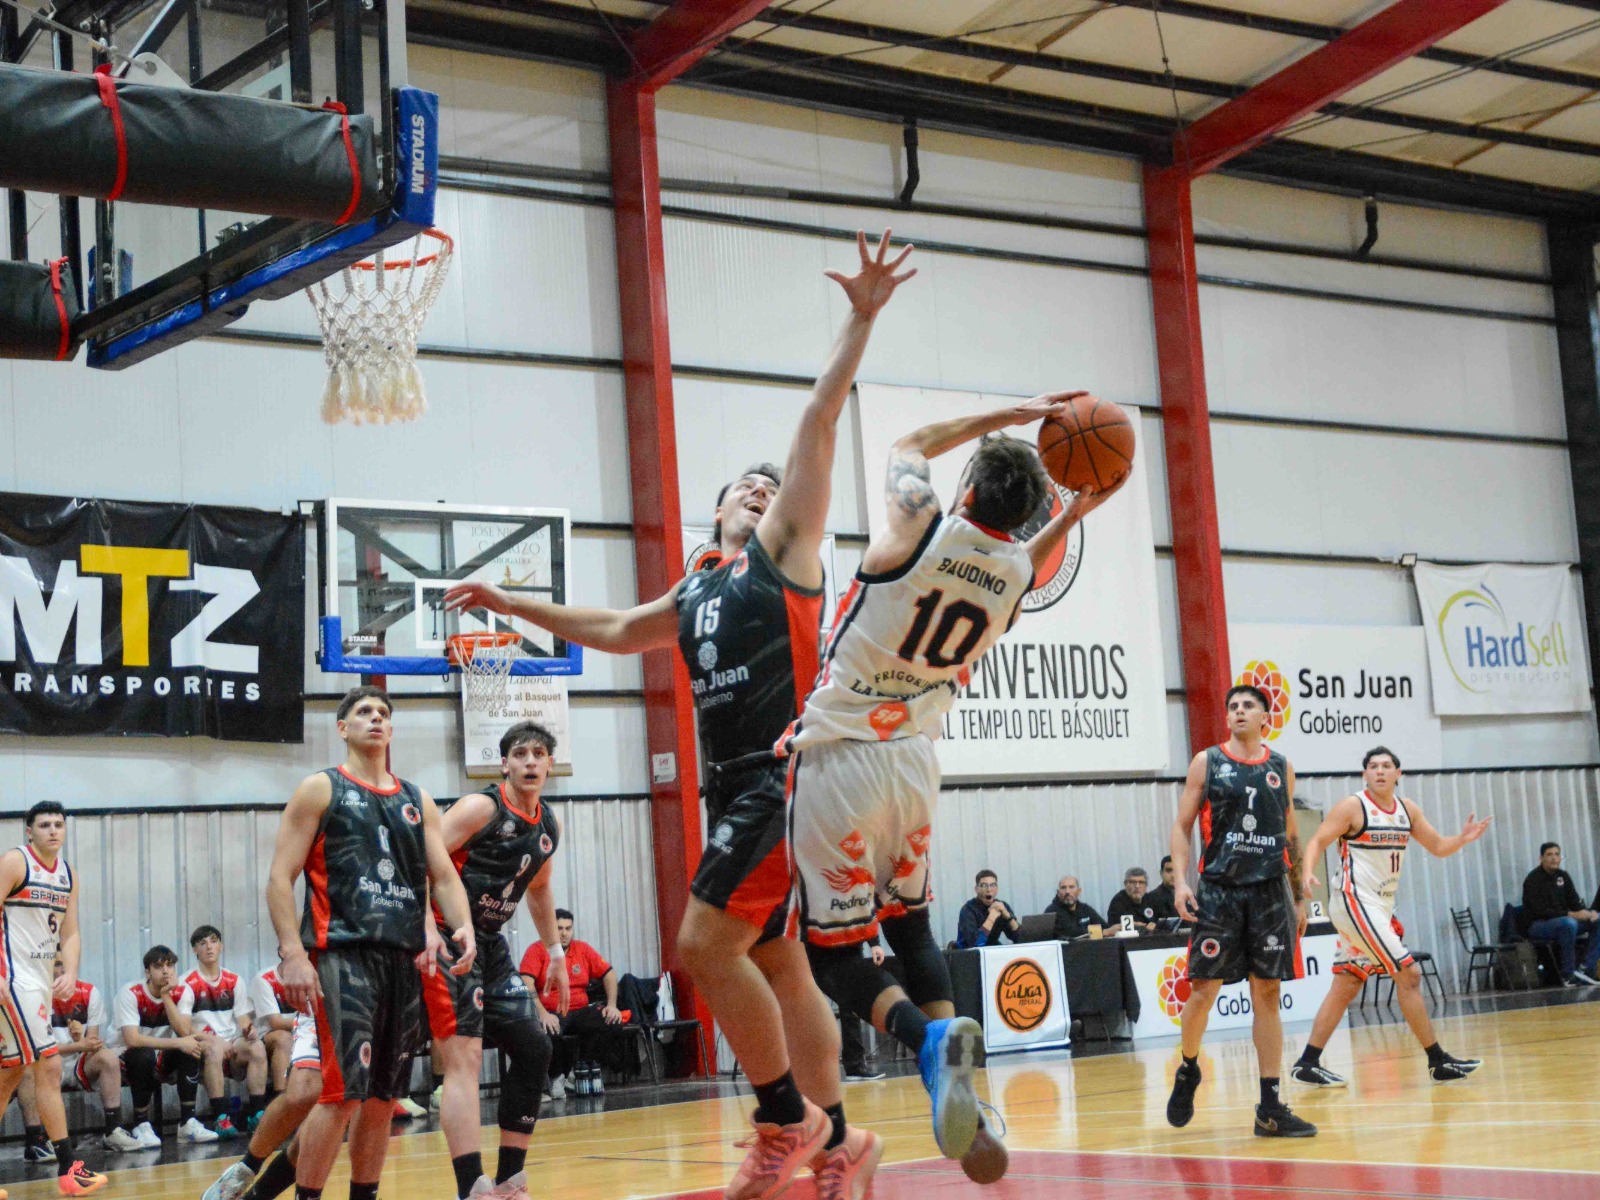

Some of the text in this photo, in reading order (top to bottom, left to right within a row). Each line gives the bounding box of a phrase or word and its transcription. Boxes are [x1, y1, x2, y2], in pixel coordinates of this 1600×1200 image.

[411, 114, 425, 194] STADIUM
[937, 557, 1007, 595] BAUDINO
[1026, 553, 1076, 605] Argentina
[0, 543, 261, 674] MTZ
[694, 596, 722, 638] 15
[896, 587, 991, 668] 10
[1465, 622, 1569, 668] HardSell
[0, 672, 261, 700] RANSPORTES
[691, 665, 749, 694] an Juan
[1298, 668, 1413, 699] San Juan
[525, 692, 562, 703] Basquet
[488, 708, 543, 717] de San Juan
[959, 709, 1024, 740] TEMPLO
[1028, 709, 1058, 739] DEL
[1062, 702, 1130, 740] BÁSQUET
[1299, 708, 1383, 735] Gobierno
[1245, 786, 1257, 810] 7
[1226, 832, 1276, 847] San Juan
[1232, 842, 1264, 854] Gobierno
[516, 854, 531, 877] 9
[1390, 852, 1400, 873] 11
[360, 876, 415, 899] San Juan
[372, 894, 404, 909] Gobierno
[479, 893, 500, 908] San
[1314, 903, 1322, 916] 2
[47, 912, 57, 934] 6
[1124, 917, 1132, 931] 2
